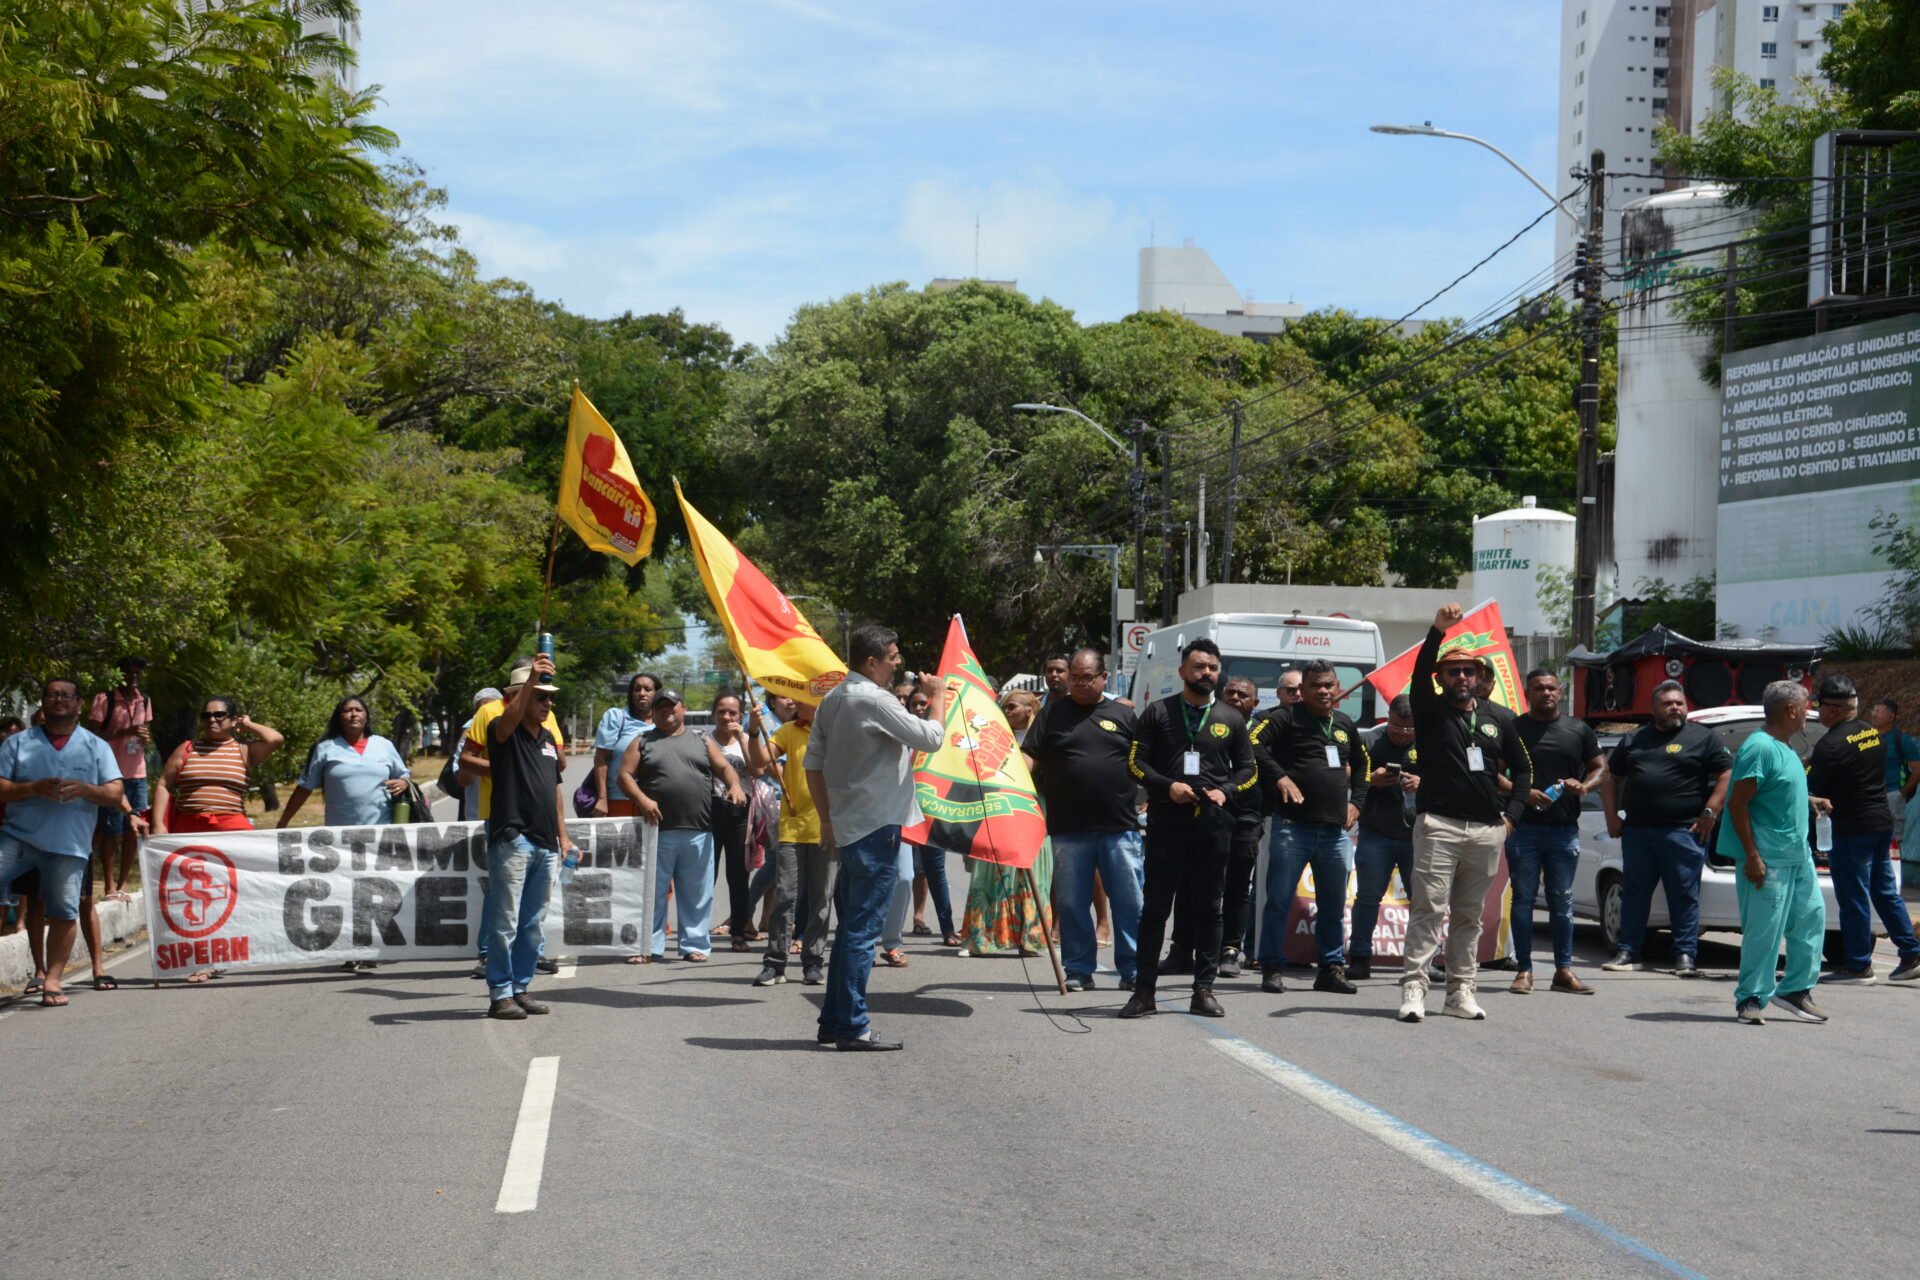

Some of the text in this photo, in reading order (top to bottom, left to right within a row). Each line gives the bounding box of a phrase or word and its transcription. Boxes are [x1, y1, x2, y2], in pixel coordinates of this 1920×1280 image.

[1726, 329, 1920, 380] REFORMA E AMPLIAÇÃO DE UNIDADE DE
[1726, 384, 1740, 398] DO
[1741, 374, 1795, 395] COMPLEXO
[1797, 361, 1859, 385] HOSPITALAR
[1733, 392, 1788, 414] AMPLIAÇÃO
[1790, 391, 1805, 405] DO
[1807, 381, 1847, 402] CENTRO
[1849, 371, 1912, 394] CIRÚRGICO;
[1722, 439, 1731, 452] III
[1738, 431, 1783, 449] REFORMA
[1785, 428, 1800, 442] DO
[1802, 421, 1843, 439] CENTRO
[1845, 410, 1907, 432] CIRÚRGICO;
[1736, 413, 1780, 432] REFORMA
[1783, 404, 1832, 424] ELÉTRICA;
[1721, 457, 1731, 469] IV
[1738, 448, 1783, 467] REFORMA
[1785, 446, 1800, 460] DO
[1802, 440, 1836, 457] BLOCO
[1838, 439, 1845, 452] B
[1853, 429, 1905, 450] SEGUNDO
[1908, 428, 1915, 441] E
[1721, 475, 1728, 487] V
[1735, 467, 1780, 485] REFORMA
[1783, 465, 1796, 478] DO
[1799, 459, 1839, 476] CENTRO
[1842, 456, 1855, 470] DE
[624, 509, 640, 528] RN
[1478, 559, 1530, 571] MARTINS
[1479, 548, 1512, 559] WHITE
[1770, 598, 1840, 625] CAIXA
[775, 678, 786, 687] de
[788, 681, 805, 691] luta
[921, 798, 1002, 818] SEGURANÇA
[277, 825, 489, 874] ESTAM
[283, 872, 638, 951] GREE.
[157, 935, 249, 970] SIPERN
